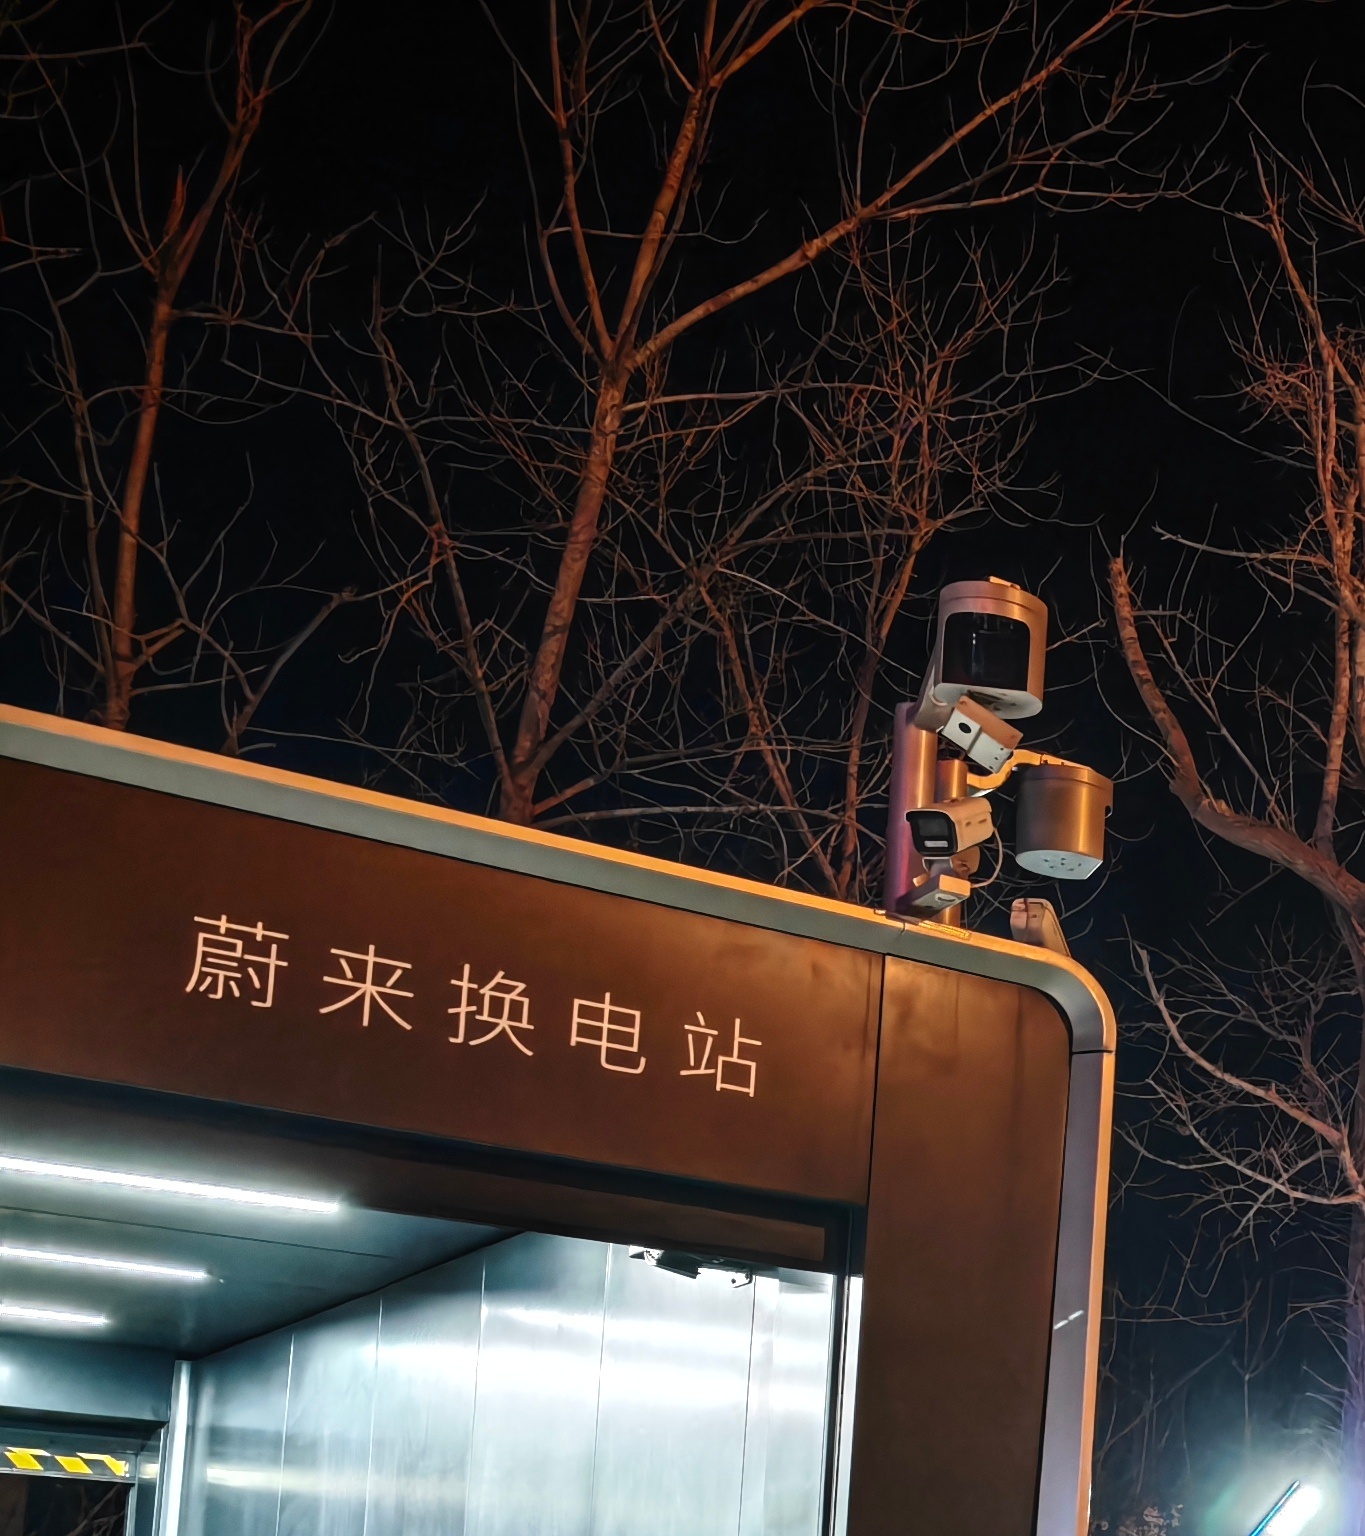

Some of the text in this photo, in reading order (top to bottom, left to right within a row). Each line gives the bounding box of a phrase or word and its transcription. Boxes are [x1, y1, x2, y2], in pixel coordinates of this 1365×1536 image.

[185, 914, 763, 1097] 蔚来换电站
